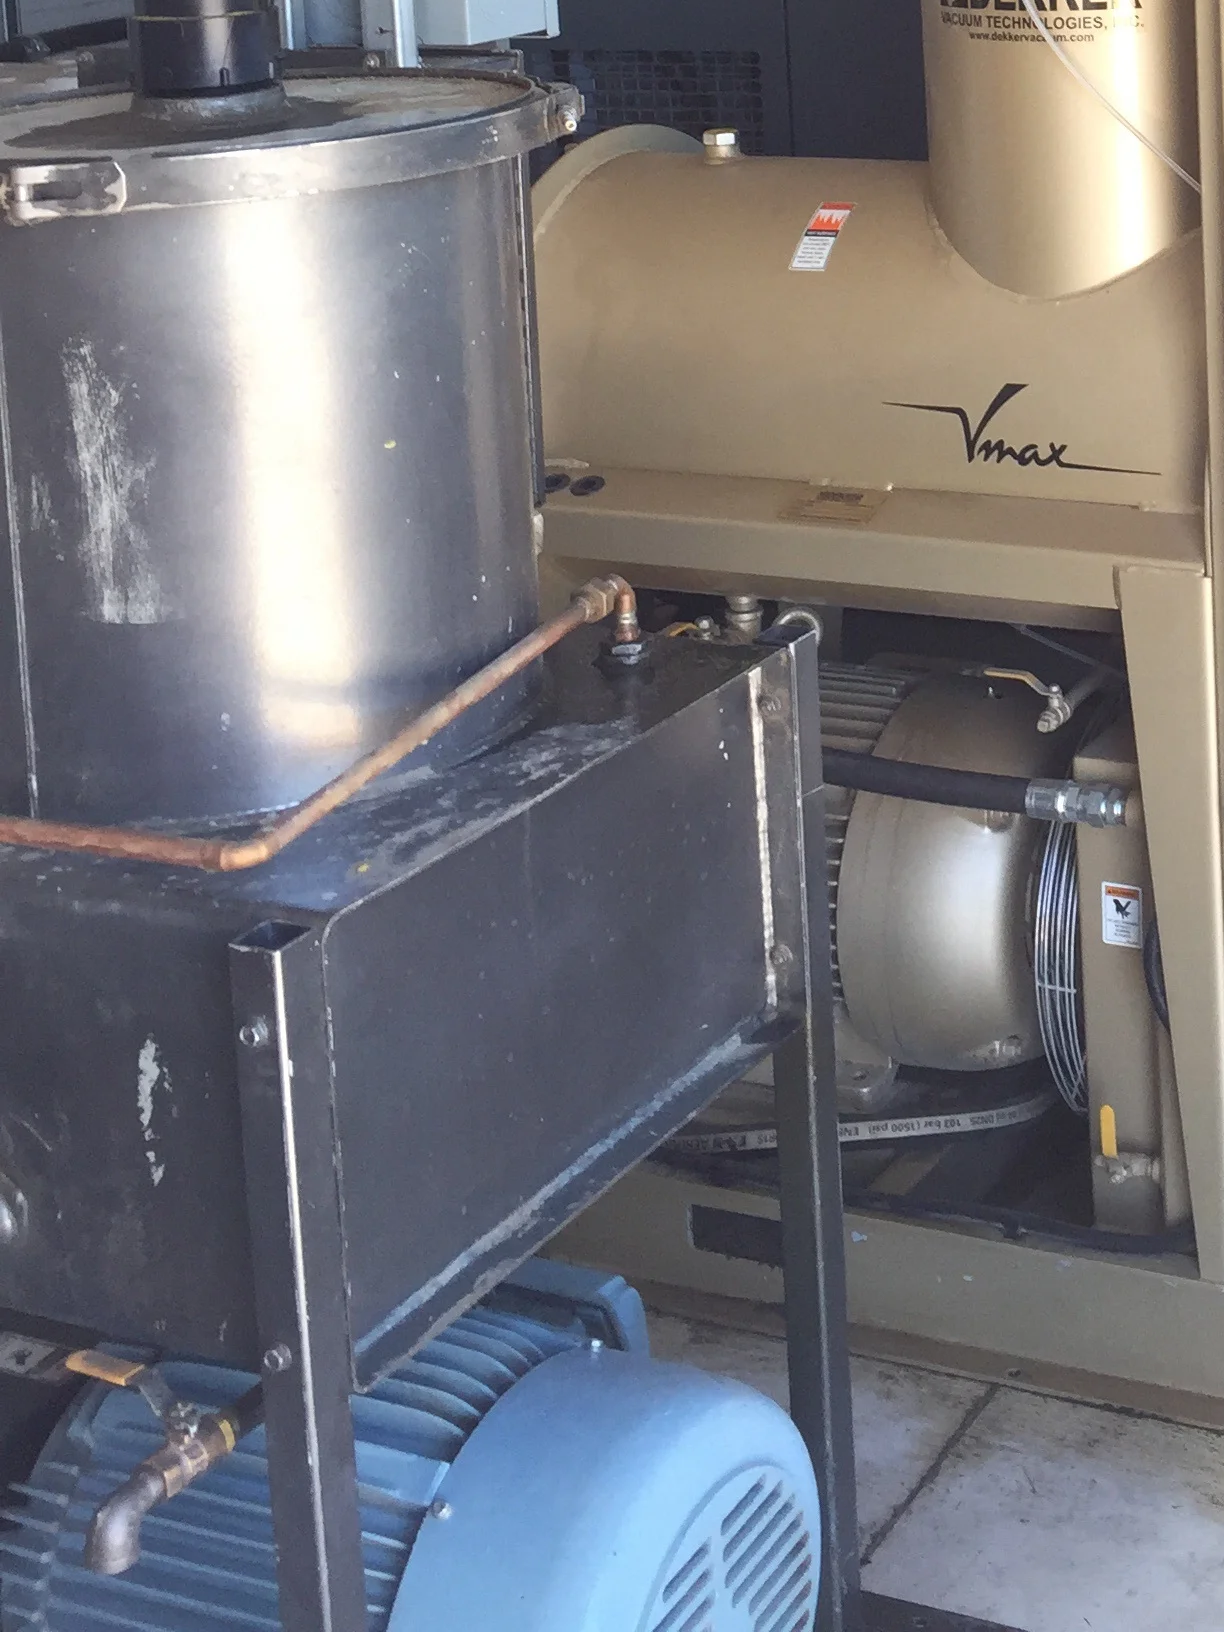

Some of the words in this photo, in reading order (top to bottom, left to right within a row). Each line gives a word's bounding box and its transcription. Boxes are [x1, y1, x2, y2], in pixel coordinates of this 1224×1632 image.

[941, 11, 982, 28] VACUUM
[923, 1120, 942, 1129] bar
[944, 1118, 961, 1128] 103
